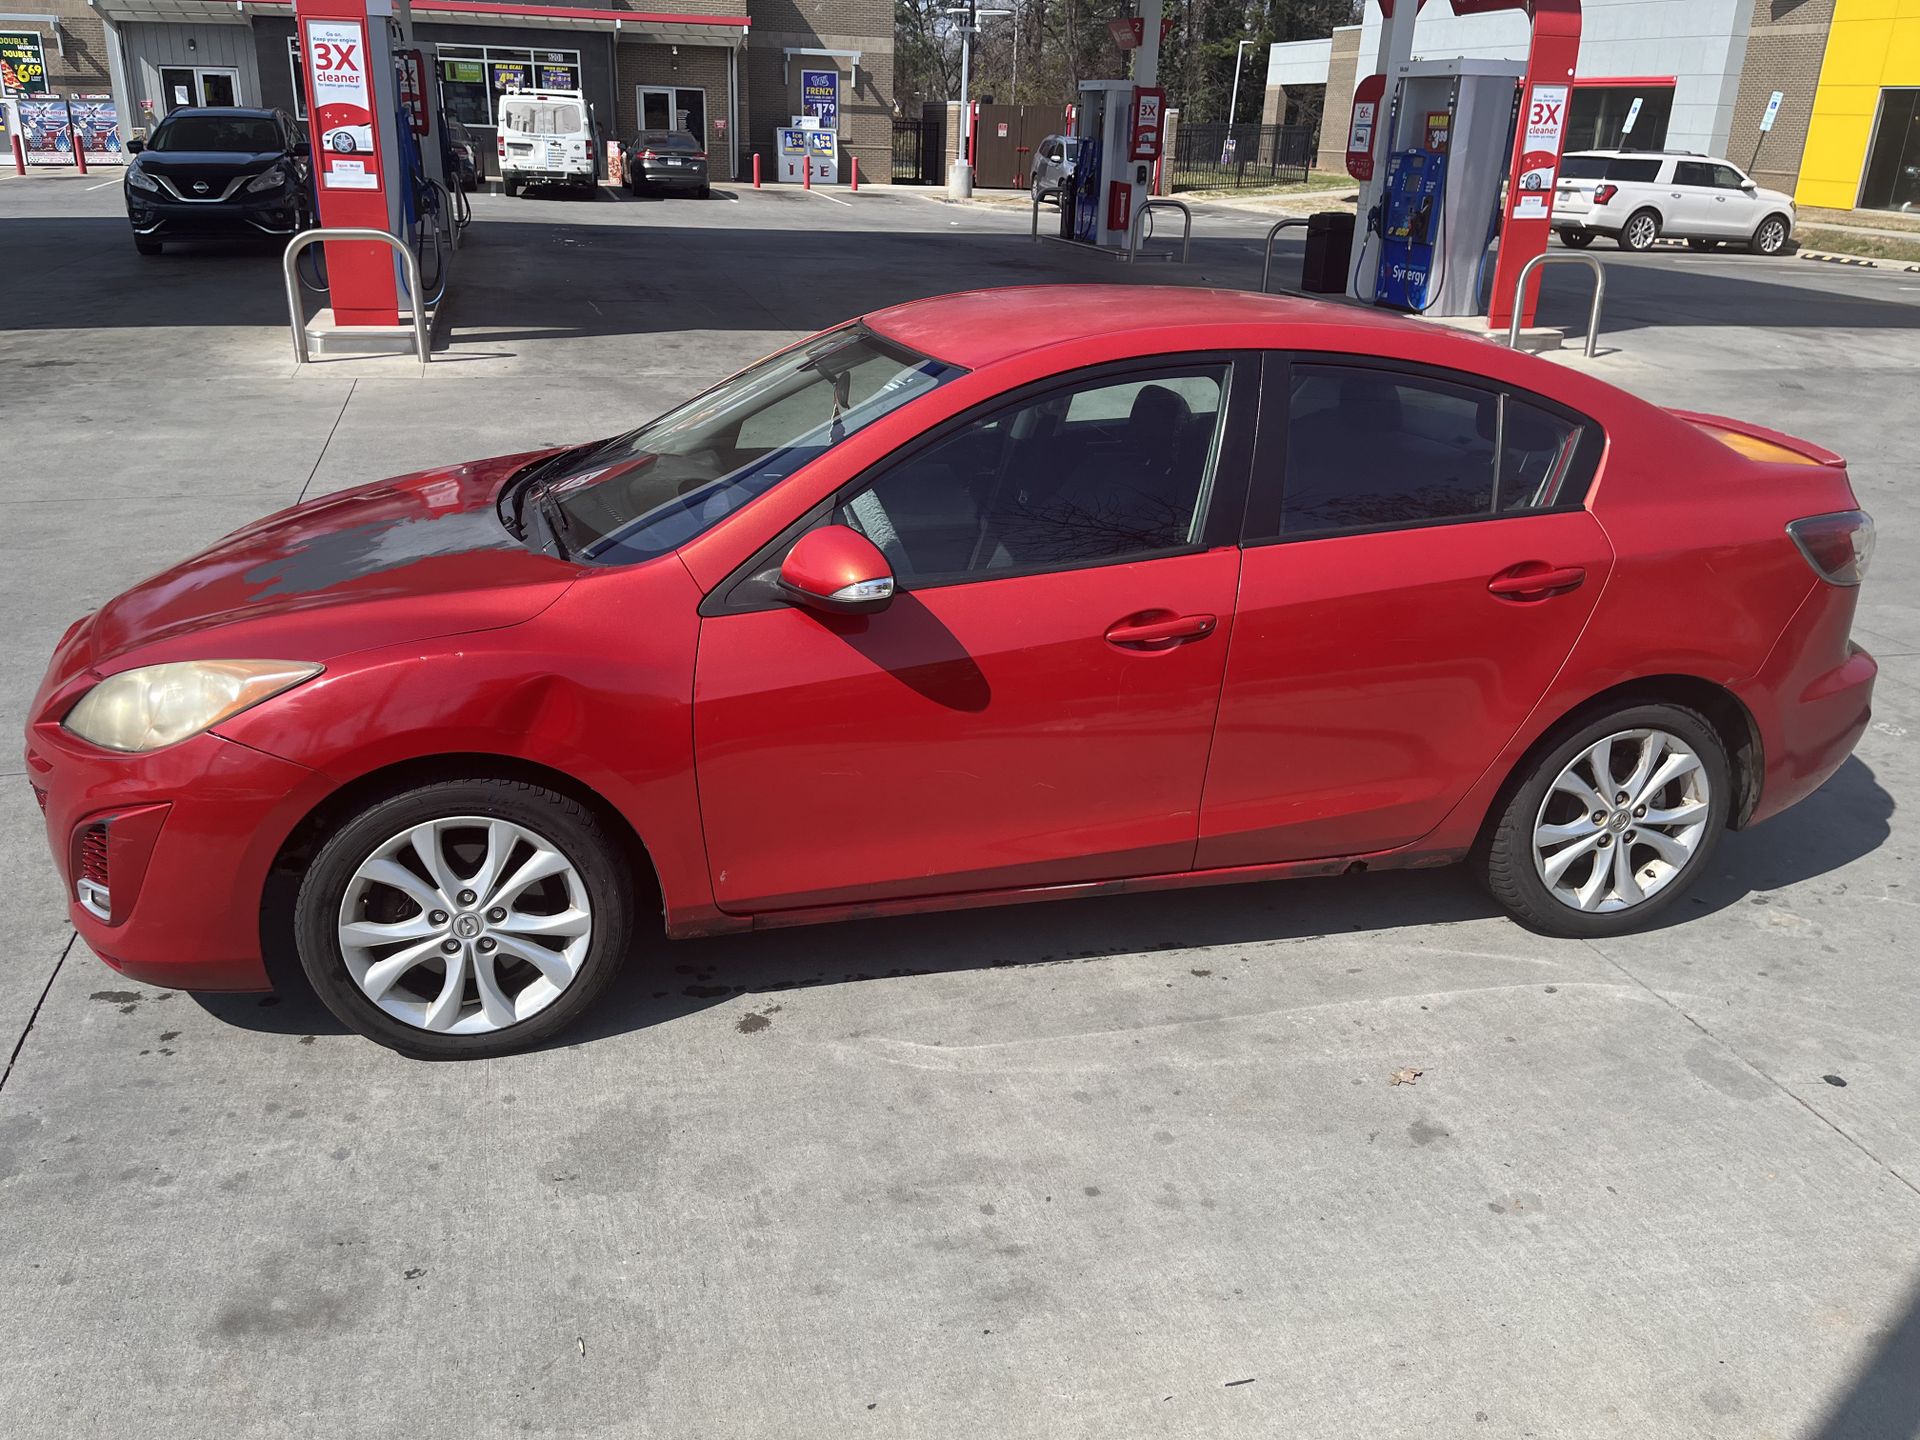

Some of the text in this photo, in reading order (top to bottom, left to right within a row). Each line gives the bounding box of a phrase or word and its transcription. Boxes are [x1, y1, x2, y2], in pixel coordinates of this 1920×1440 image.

[1134, 22, 1140, 32] 2
[0, 37, 29, 45] DOUBLE
[3, 50, 33, 58] DOUBLE
[314, 43, 359, 72] 3X
[317, 71, 360, 83] cleaner
[806, 87, 835, 96] FRENZY
[1140, 104, 1157, 117] 3X
[1530, 103, 1562, 125] 3X
[1528, 126, 1558, 135] cleaner
